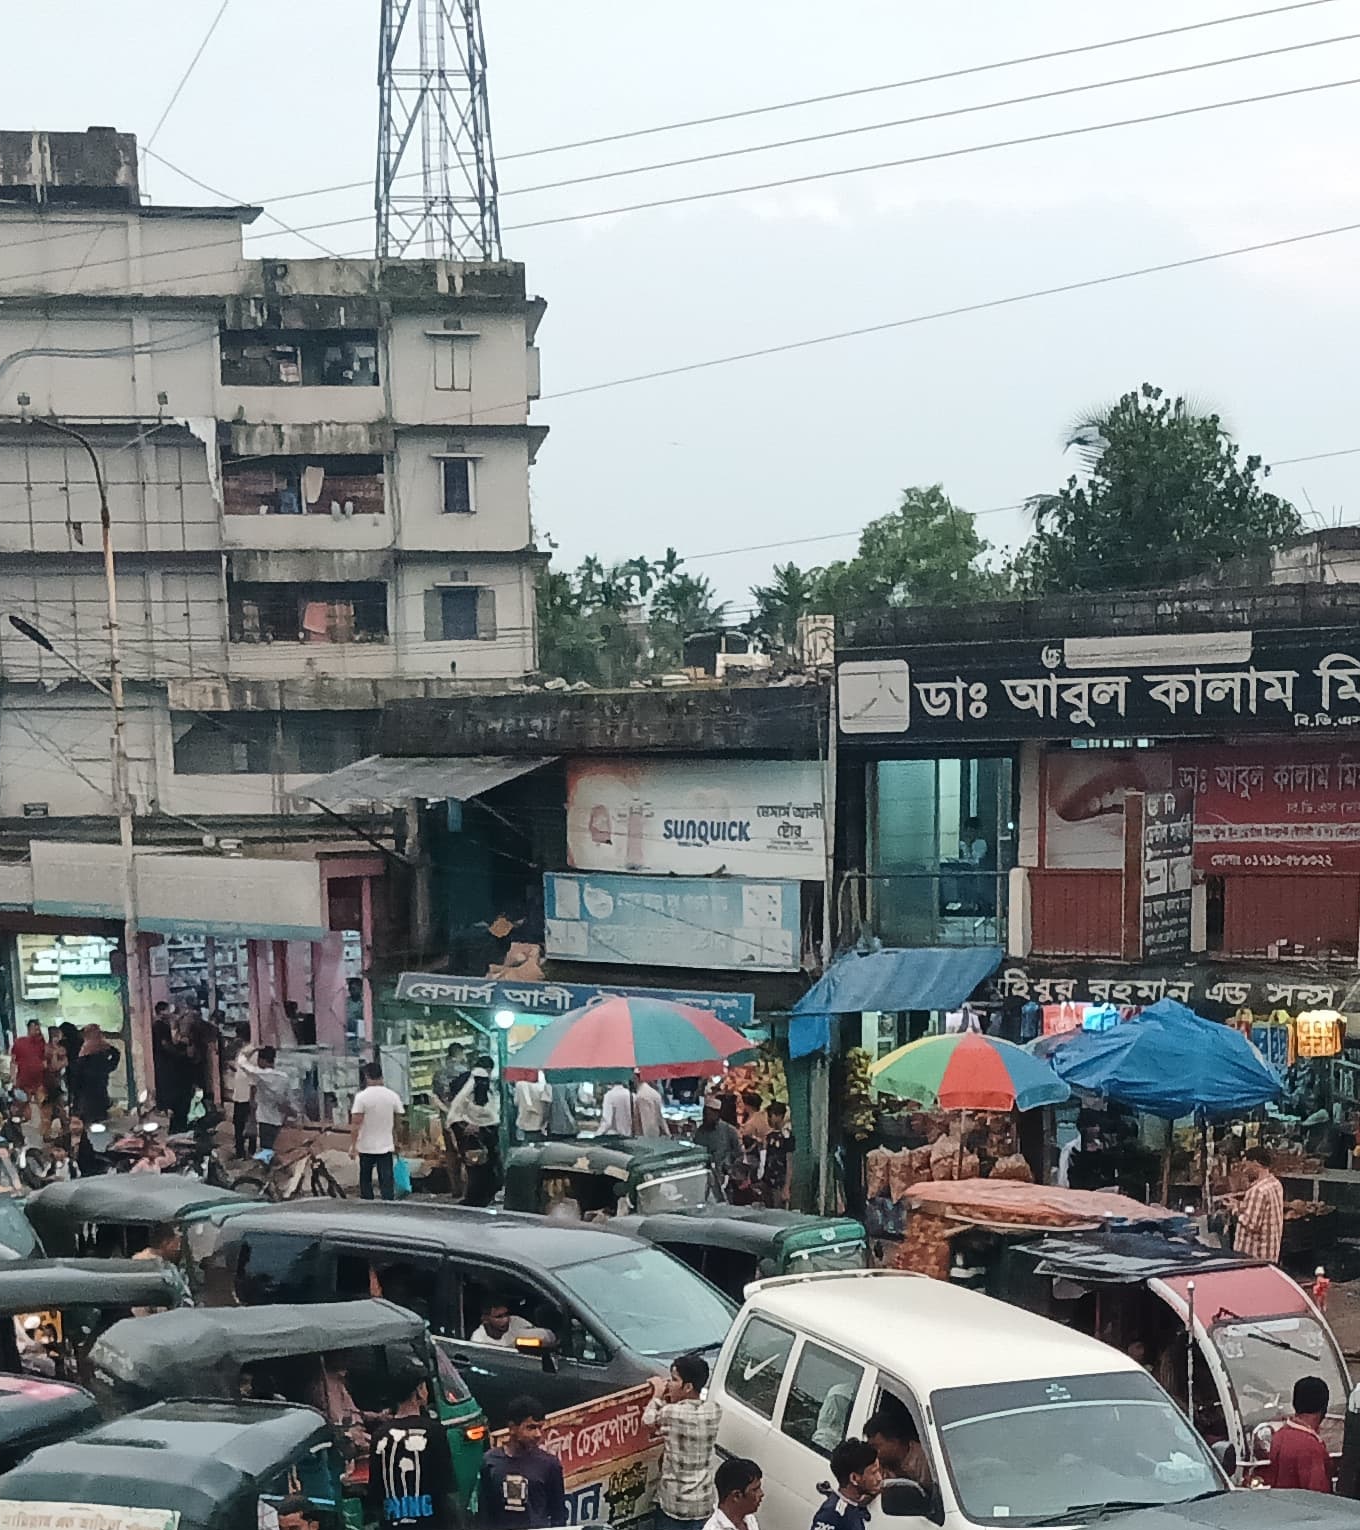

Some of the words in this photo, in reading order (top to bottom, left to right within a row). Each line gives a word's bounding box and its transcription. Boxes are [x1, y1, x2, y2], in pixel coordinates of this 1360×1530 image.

[913, 675, 988, 721] ডাঃ
[1000, 672, 1132, 727] আবুল
[1142, 666, 1299, 714] কালাম
[1214, 764, 1265, 800] আবুল
[1272, 763, 1330, 793] কালাম
[662, 818, 751, 844] SUNQUICK
[405, 982, 497, 1004] মেসার্স
[502, 985, 575, 1011] আলী
[1087, 976, 1194, 1004] রহমান
[1266, 981, 1339, 1008] সন্স
